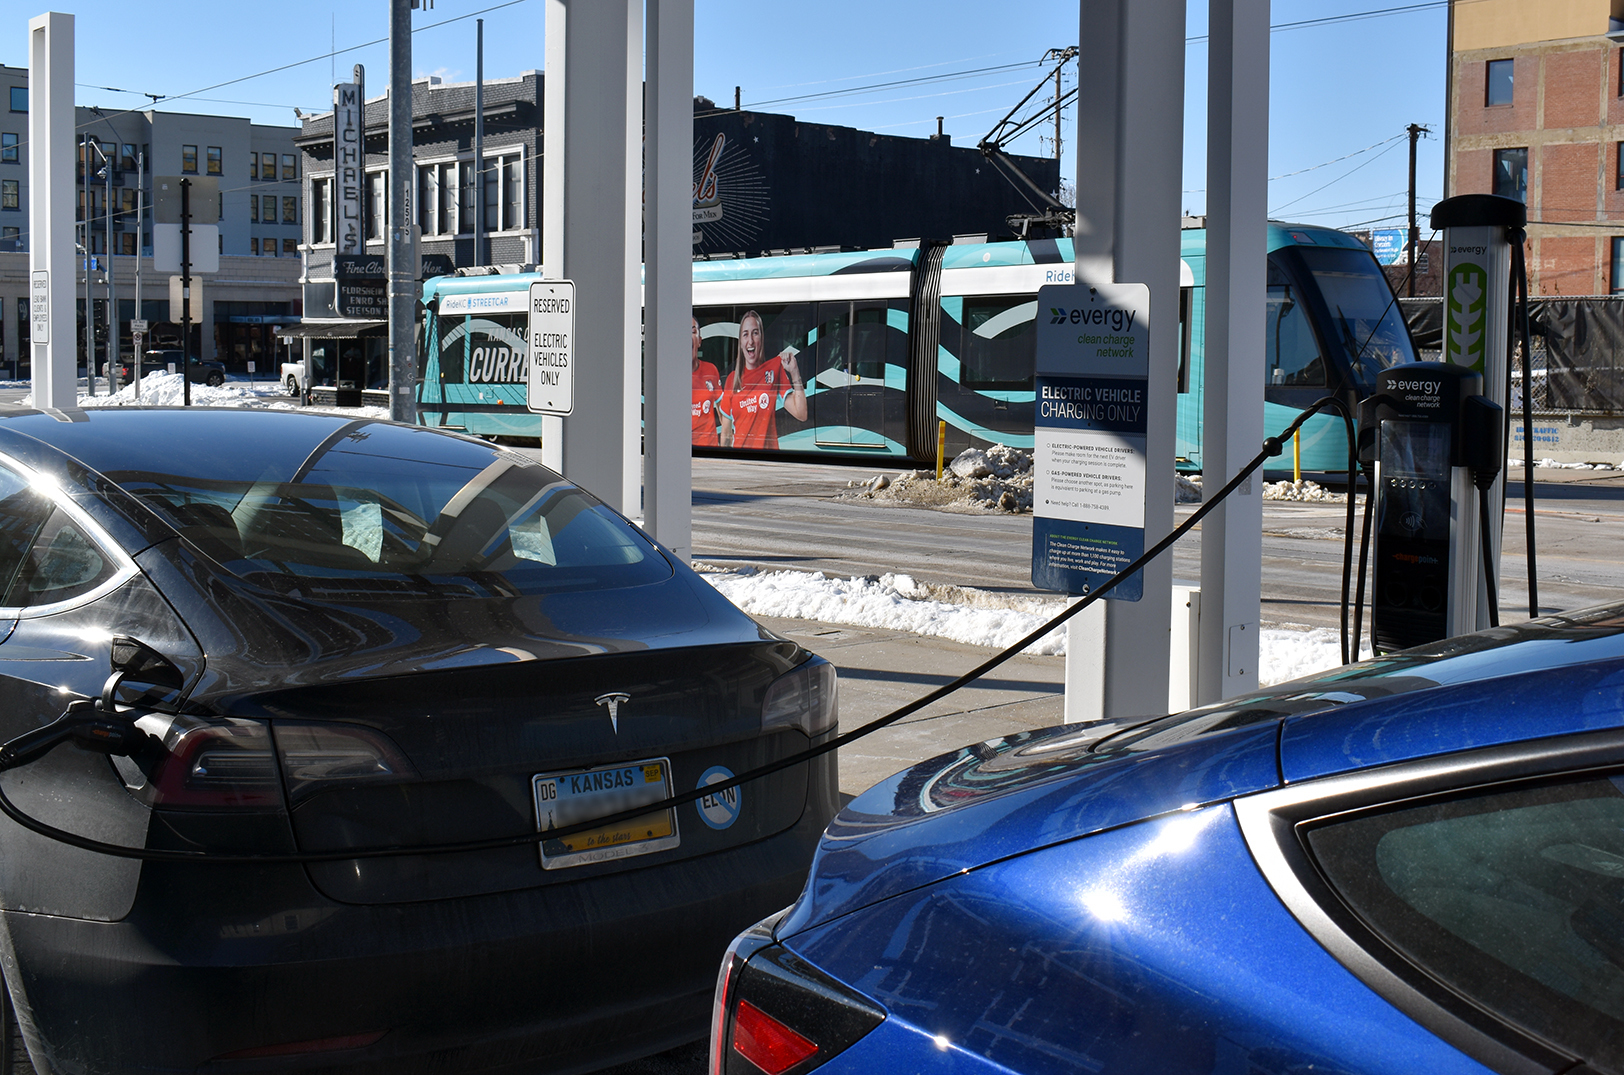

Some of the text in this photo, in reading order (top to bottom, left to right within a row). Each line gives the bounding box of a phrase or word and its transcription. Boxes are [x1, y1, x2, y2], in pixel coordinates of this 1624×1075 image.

[340, 89, 358, 247] MICHAEL'S
[1458, 245, 1487, 256] evergy
[342, 261, 364, 274] Fine
[1046, 270, 1076, 282] Ride
[350, 296, 373, 305] ENRO
[446, 297, 508, 308] RideKC STREETCAR
[534, 298, 570, 314] RESERVED
[346, 306, 381, 315] STETSON
[1070, 309, 1136, 332] evergy
[488, 327, 523, 342] KANSAS
[534, 333, 568, 349] ELECTRIC
[1078, 334, 1135, 348] clean charge
[534, 352, 568, 368] VEHICLES
[1096, 348, 1134, 358] network
[470, 347, 528, 382] CURRE
[540, 370, 560, 386] ONLY
[1398, 380, 1441, 394] evergy
[739, 395, 757, 408] United
[1042, 386, 1141, 403] ELECTRIC VEHICLE
[747, 405, 757, 413] Way
[1041, 401, 1140, 422] CHARGING ONLY
[1052, 443, 1094, 451] ELECTRIC-POWERED
[541, 769, 659, 801] DG KANSAS SEP
[702, 787, 735, 809] ELN
[587, 832, 631, 846] to the stars
[578, 847, 633, 863] MODEL
